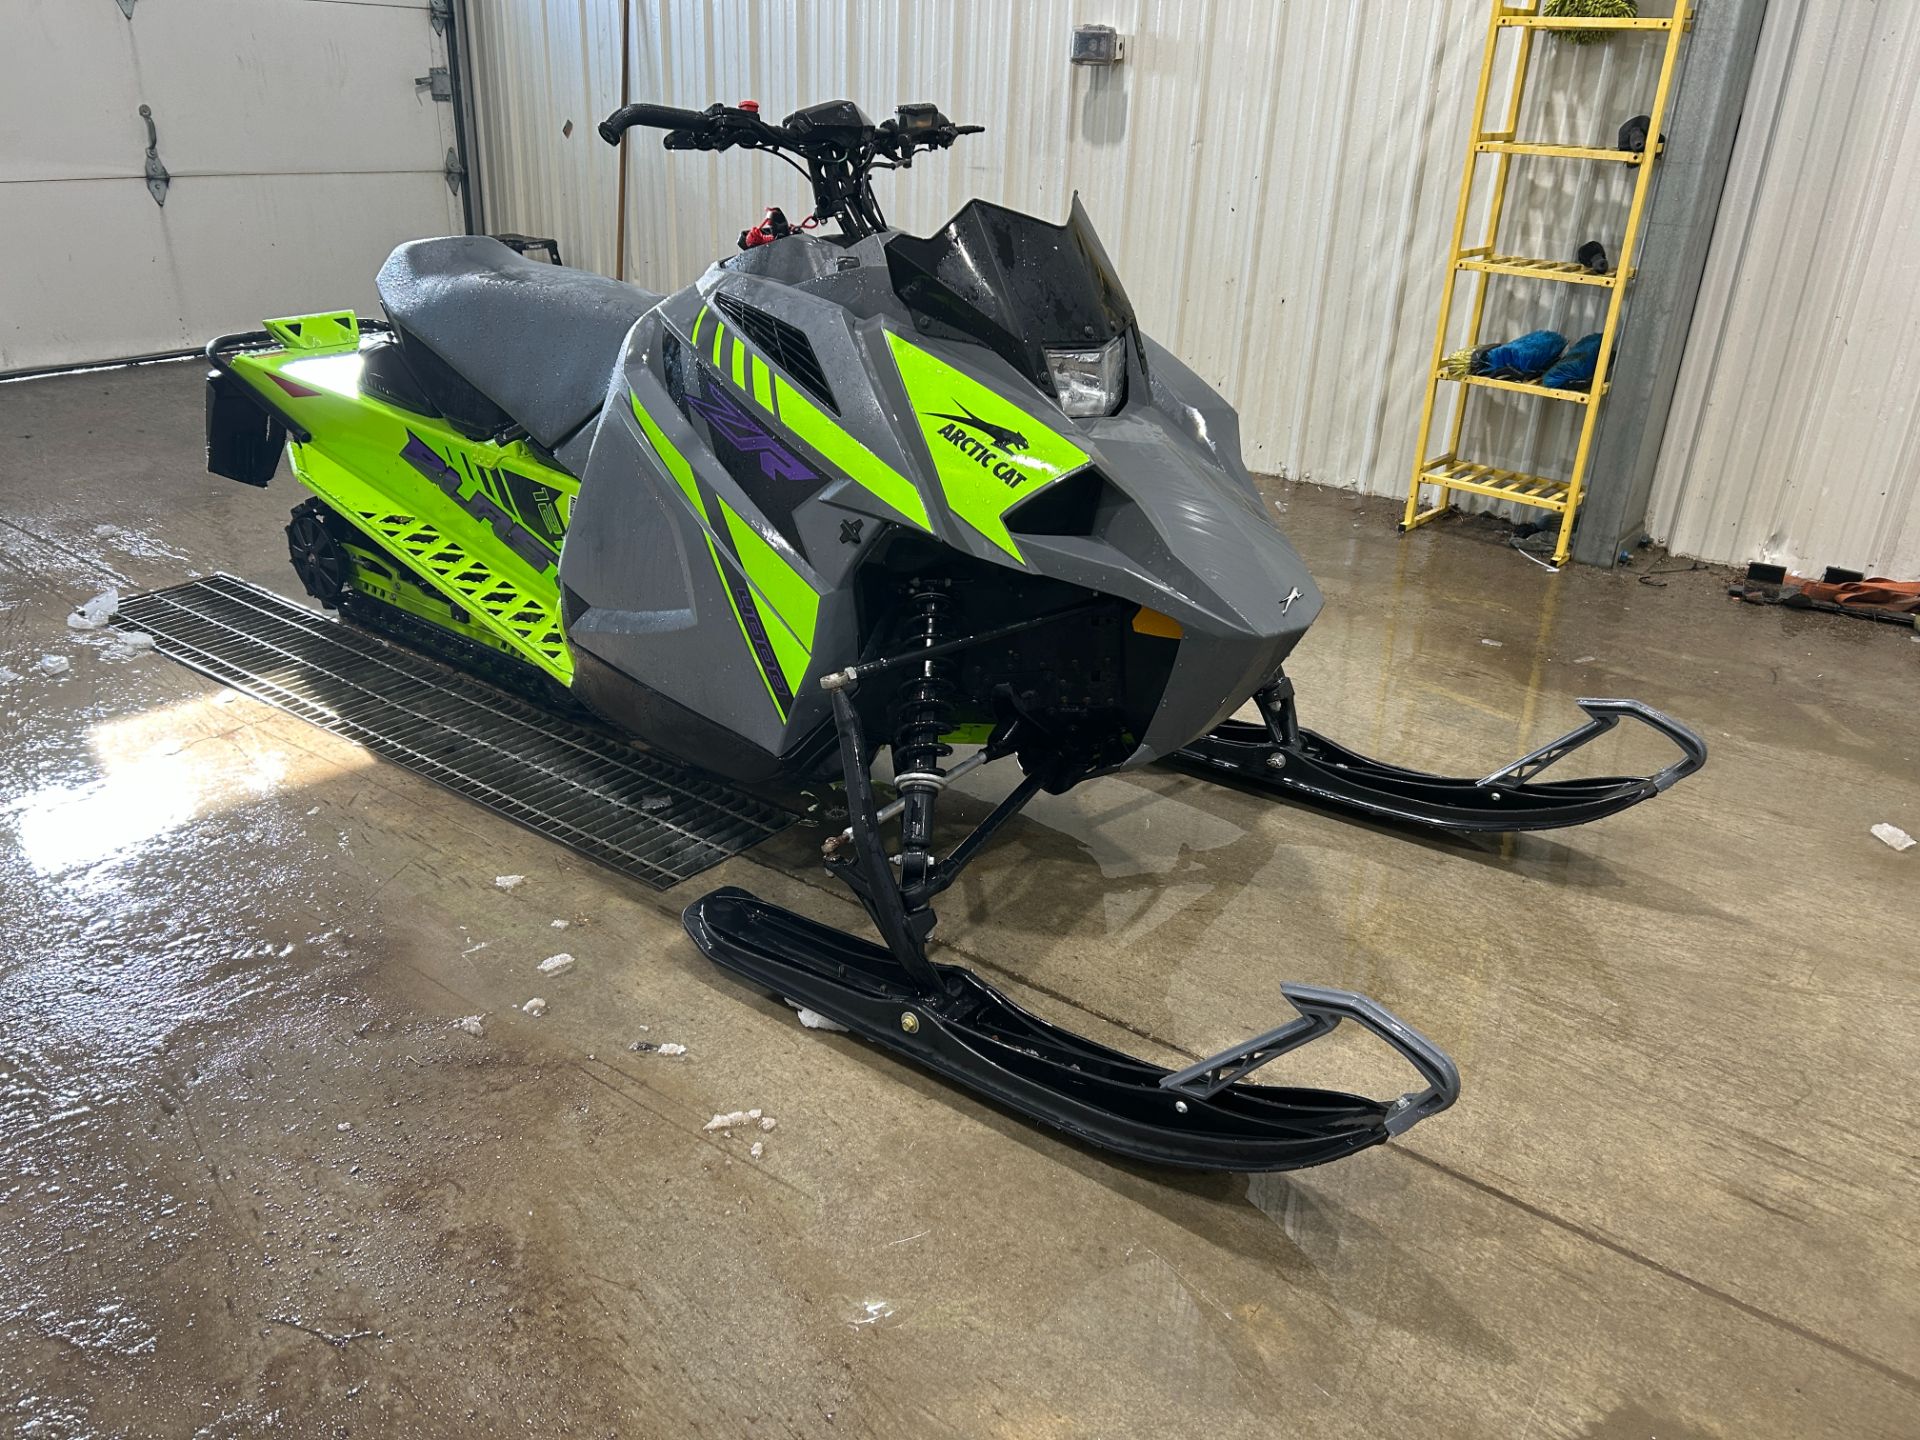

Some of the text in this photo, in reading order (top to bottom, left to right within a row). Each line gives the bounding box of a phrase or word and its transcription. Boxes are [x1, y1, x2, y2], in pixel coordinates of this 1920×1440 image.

[685, 383, 820, 481] ZR
[937, 423, 1028, 489] ARCTIC CAT
[735, 588, 789, 696] 4000
